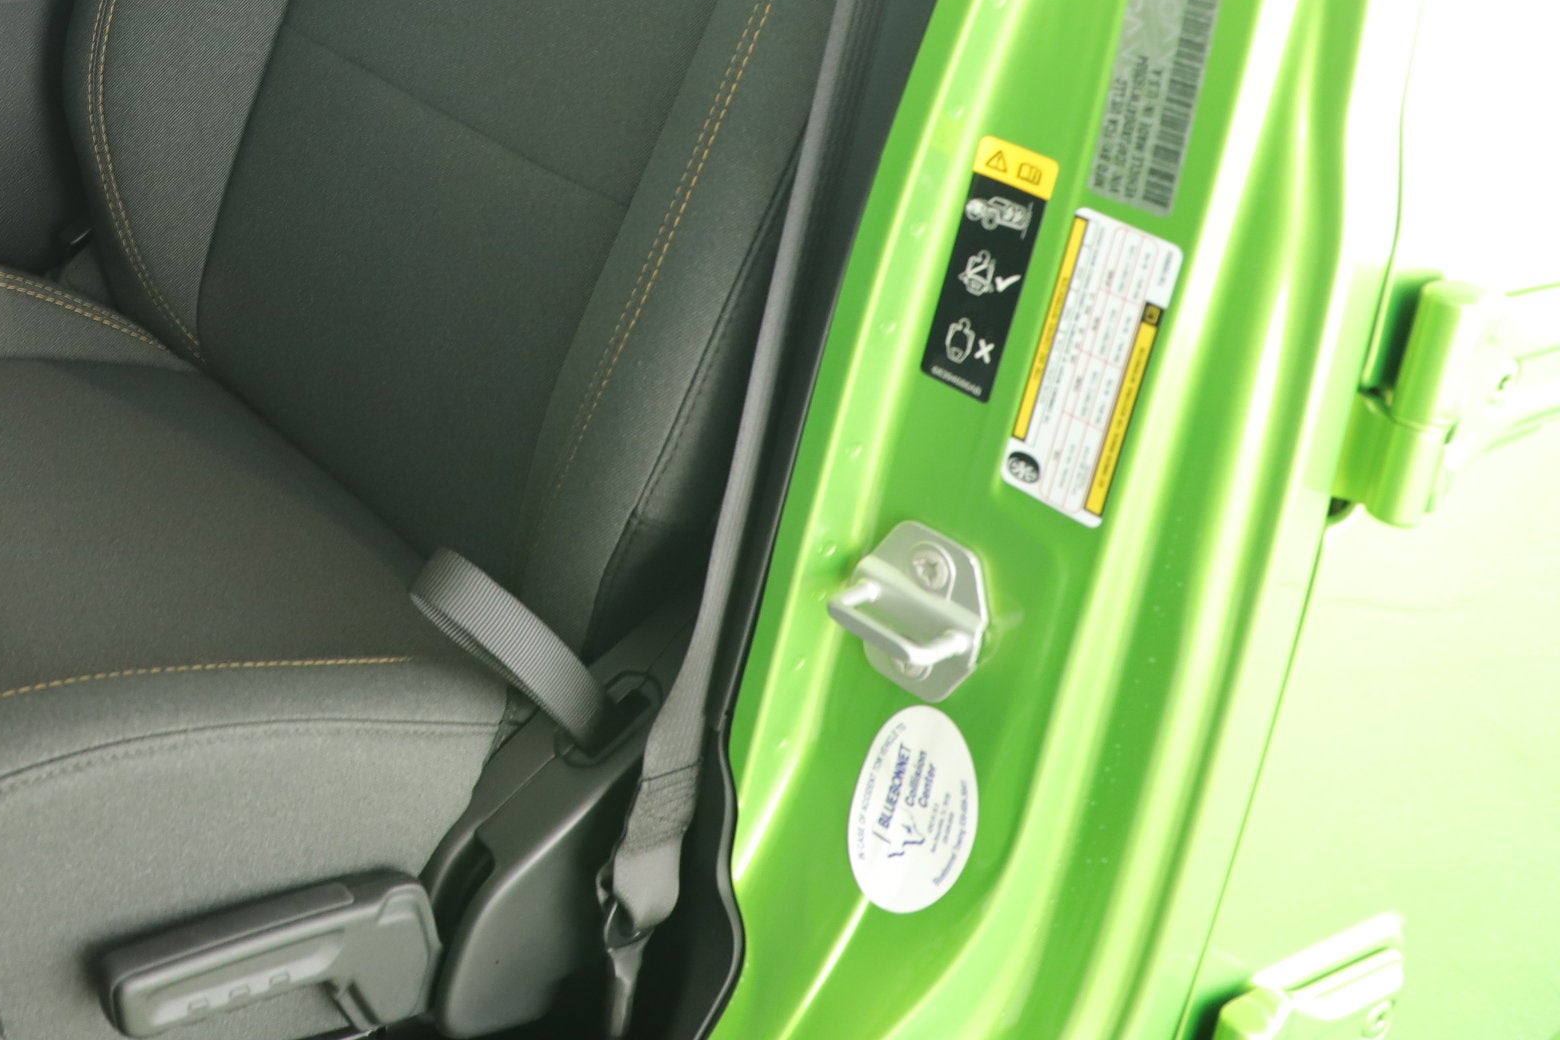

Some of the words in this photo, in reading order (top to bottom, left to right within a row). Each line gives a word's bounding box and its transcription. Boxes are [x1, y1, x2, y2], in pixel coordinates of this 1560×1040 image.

[878, 743, 911, 828] BLUEBONNET
[905, 750, 927, 806] Collision
[918, 763, 937, 808] Center
